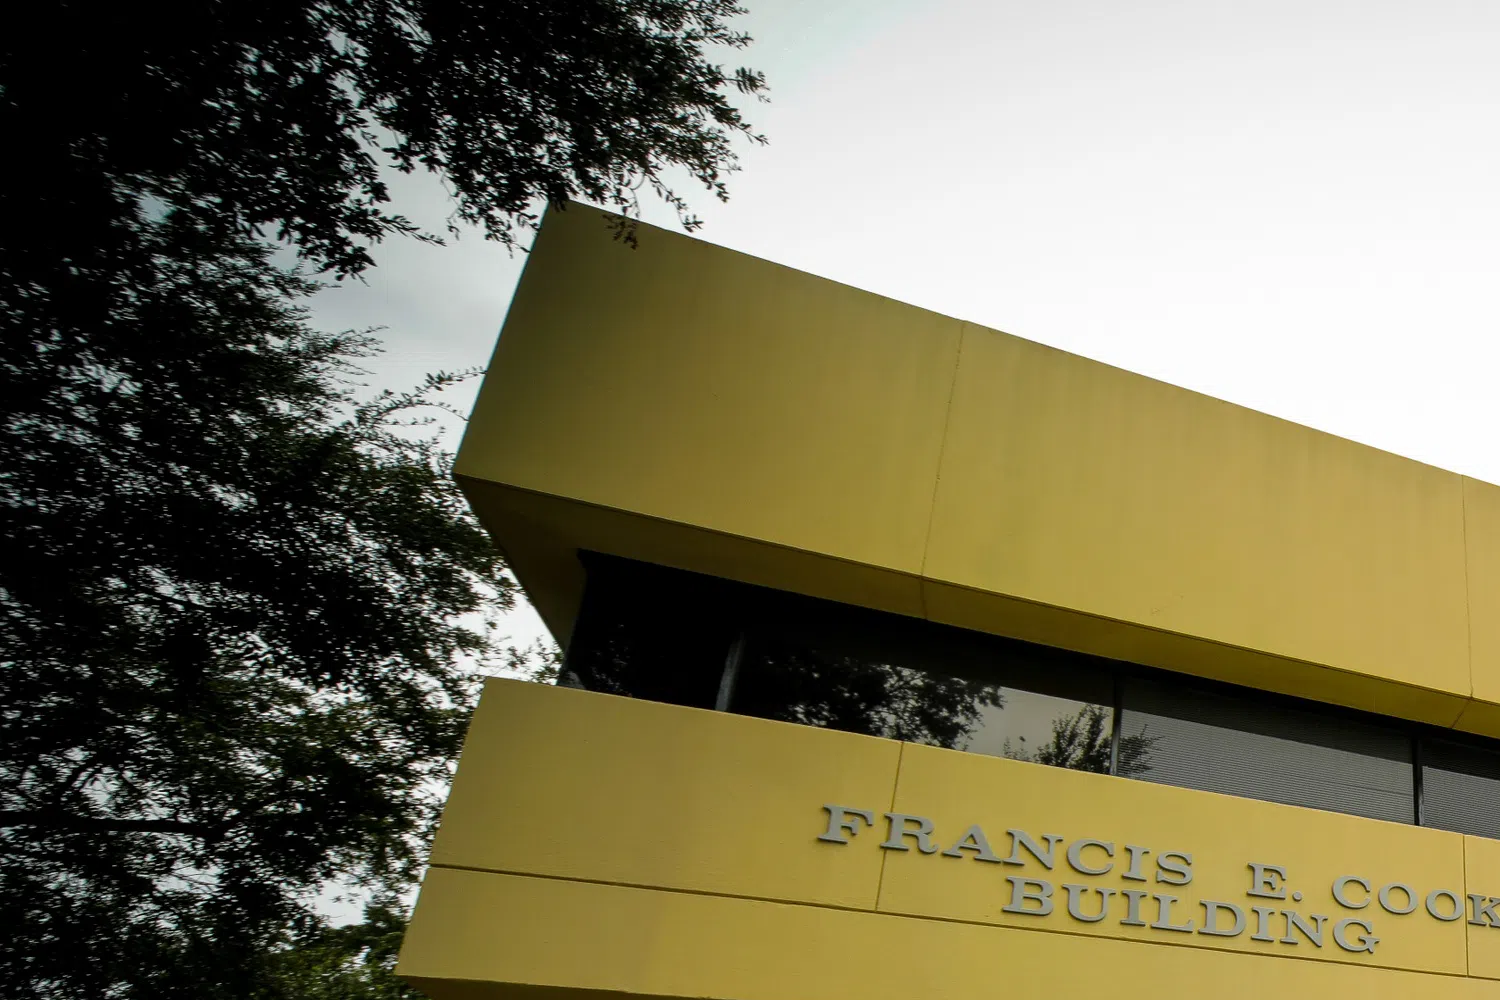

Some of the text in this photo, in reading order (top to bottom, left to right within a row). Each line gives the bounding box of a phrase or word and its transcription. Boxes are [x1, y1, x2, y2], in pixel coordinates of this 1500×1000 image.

[816, 803, 1195, 887] FRANCIS
[1246, 862, 1303, 902] E.
[1000, 875, 1381, 955] BUILDING
